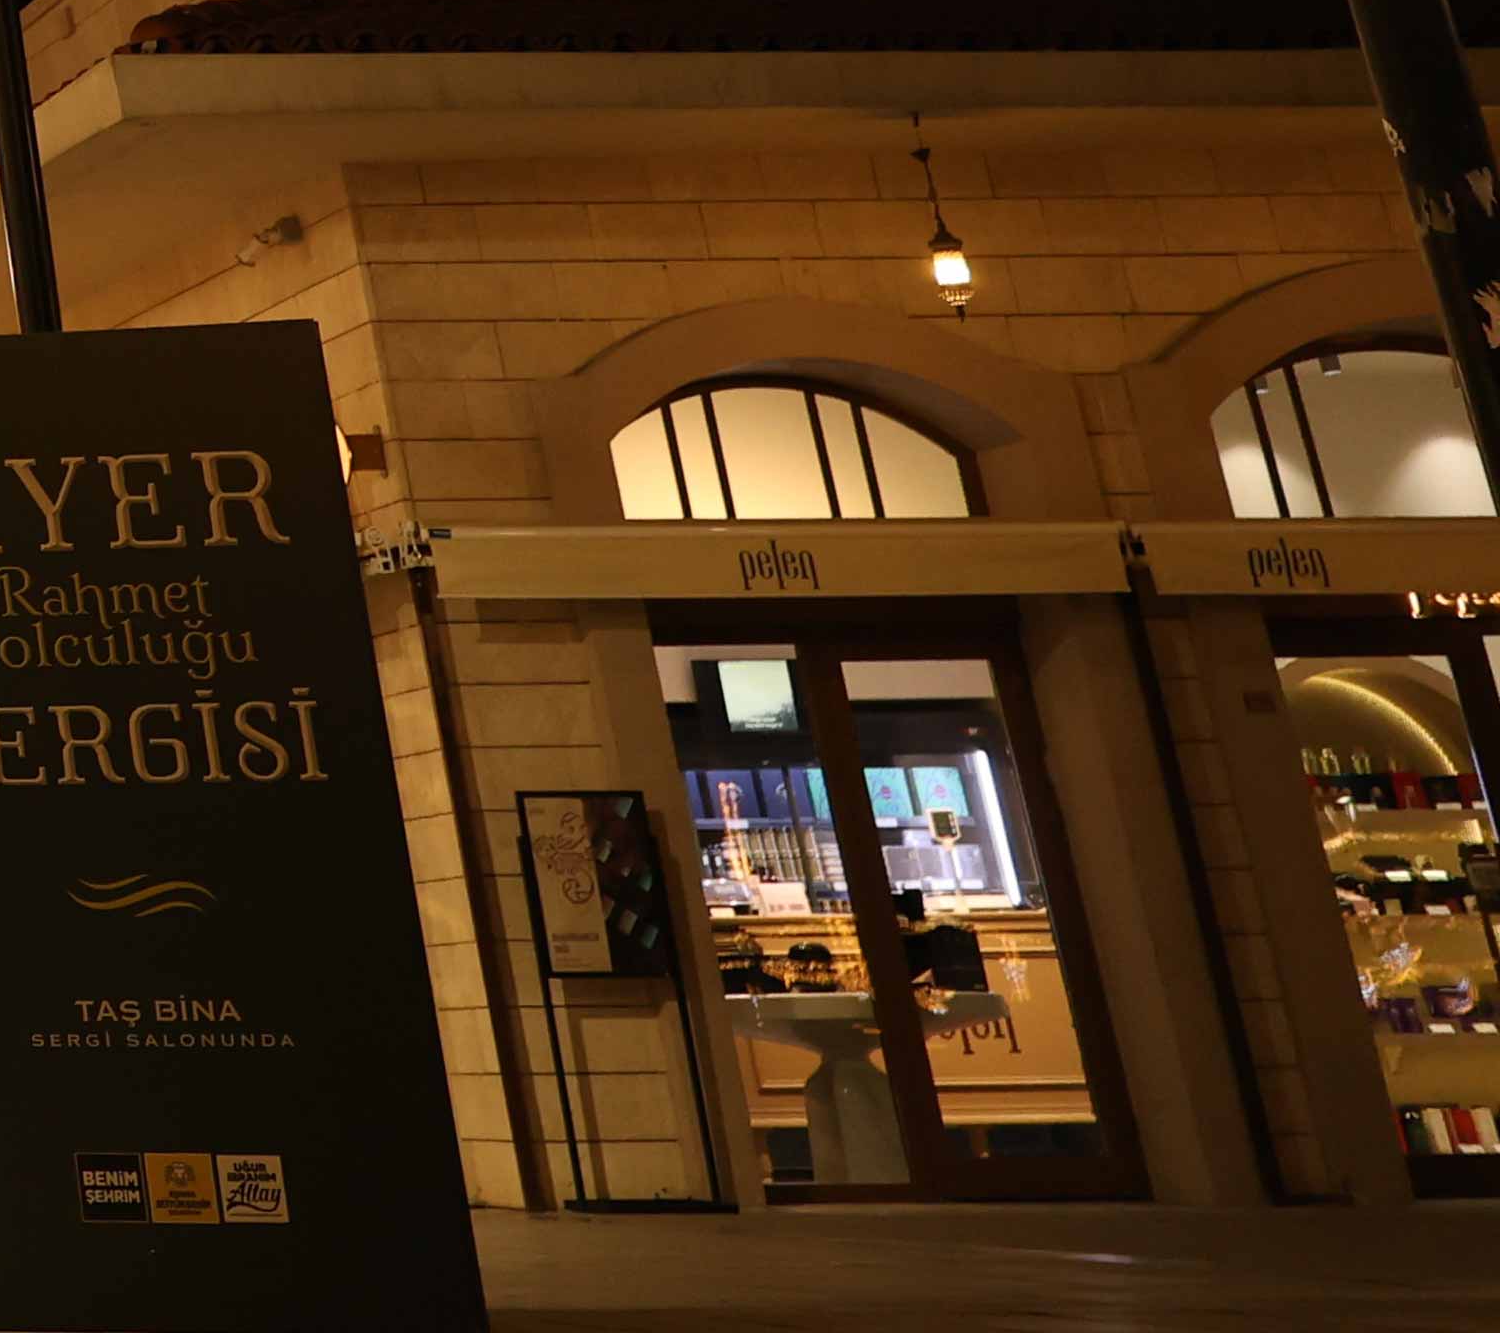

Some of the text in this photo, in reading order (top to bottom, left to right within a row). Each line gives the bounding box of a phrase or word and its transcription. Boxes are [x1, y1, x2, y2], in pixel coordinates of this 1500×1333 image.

[74, 993, 243, 1028] TAŞ BİNA
[30, 1030, 297, 1049] SERGİ SALONUNDA
[82, 1170, 139, 1187] BENİM
[84, 1188, 142, 1205] ŞEHRİM
